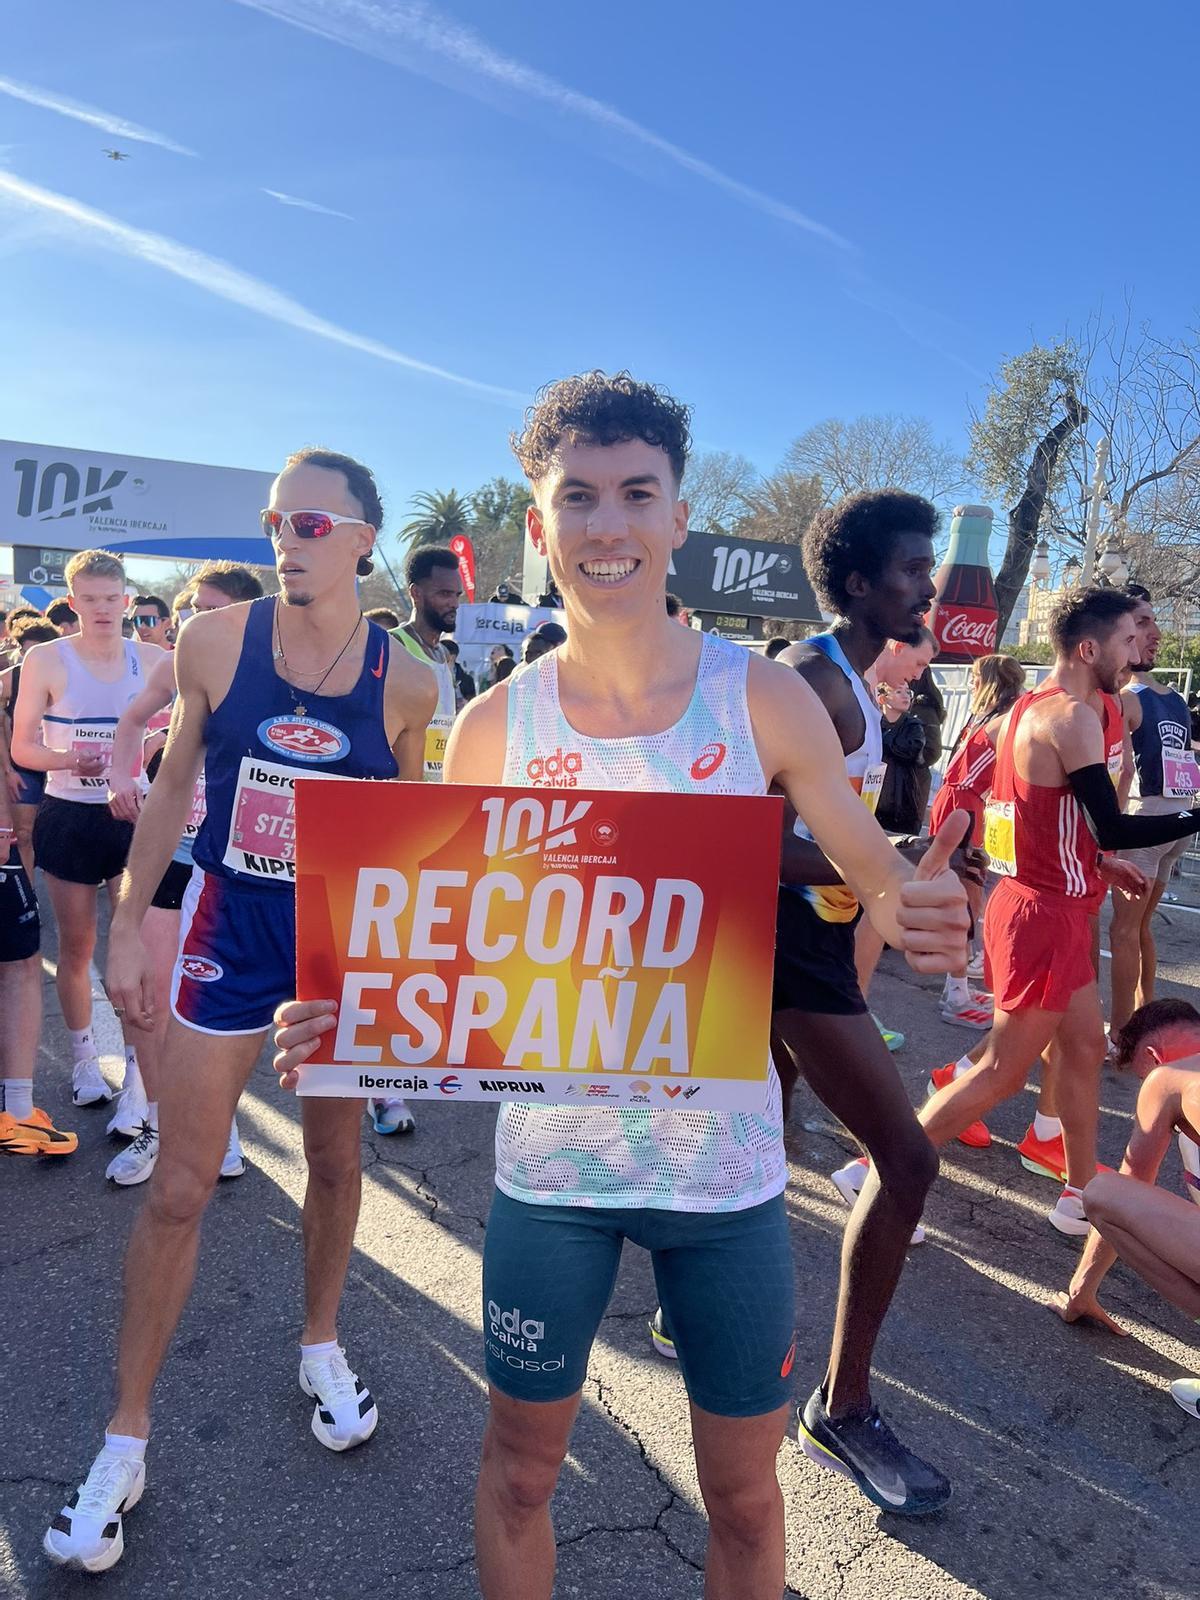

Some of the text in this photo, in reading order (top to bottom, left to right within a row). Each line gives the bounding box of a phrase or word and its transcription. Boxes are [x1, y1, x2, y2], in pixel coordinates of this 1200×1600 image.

[14, 459, 128, 522] 10K
[88, 515, 128, 527] VALENCIA
[129, 520, 168, 532] IBERCAJA
[711, 546, 780, 595] 10K
[527, 747, 582, 780] ada
[1174, 771, 1193, 787] 493
[481, 797, 594, 860] 10K
[543, 853, 617, 864] VALENCIA IBERCAJA
[347, 866, 705, 969] RECORD
[333, 967, 690, 1074] ESPAÑA
[358, 1075, 546, 1093] Ibercaja KIPRUN
[488, 1300, 545, 1339] ada
[491, 1322, 537, 1352] Calvià
